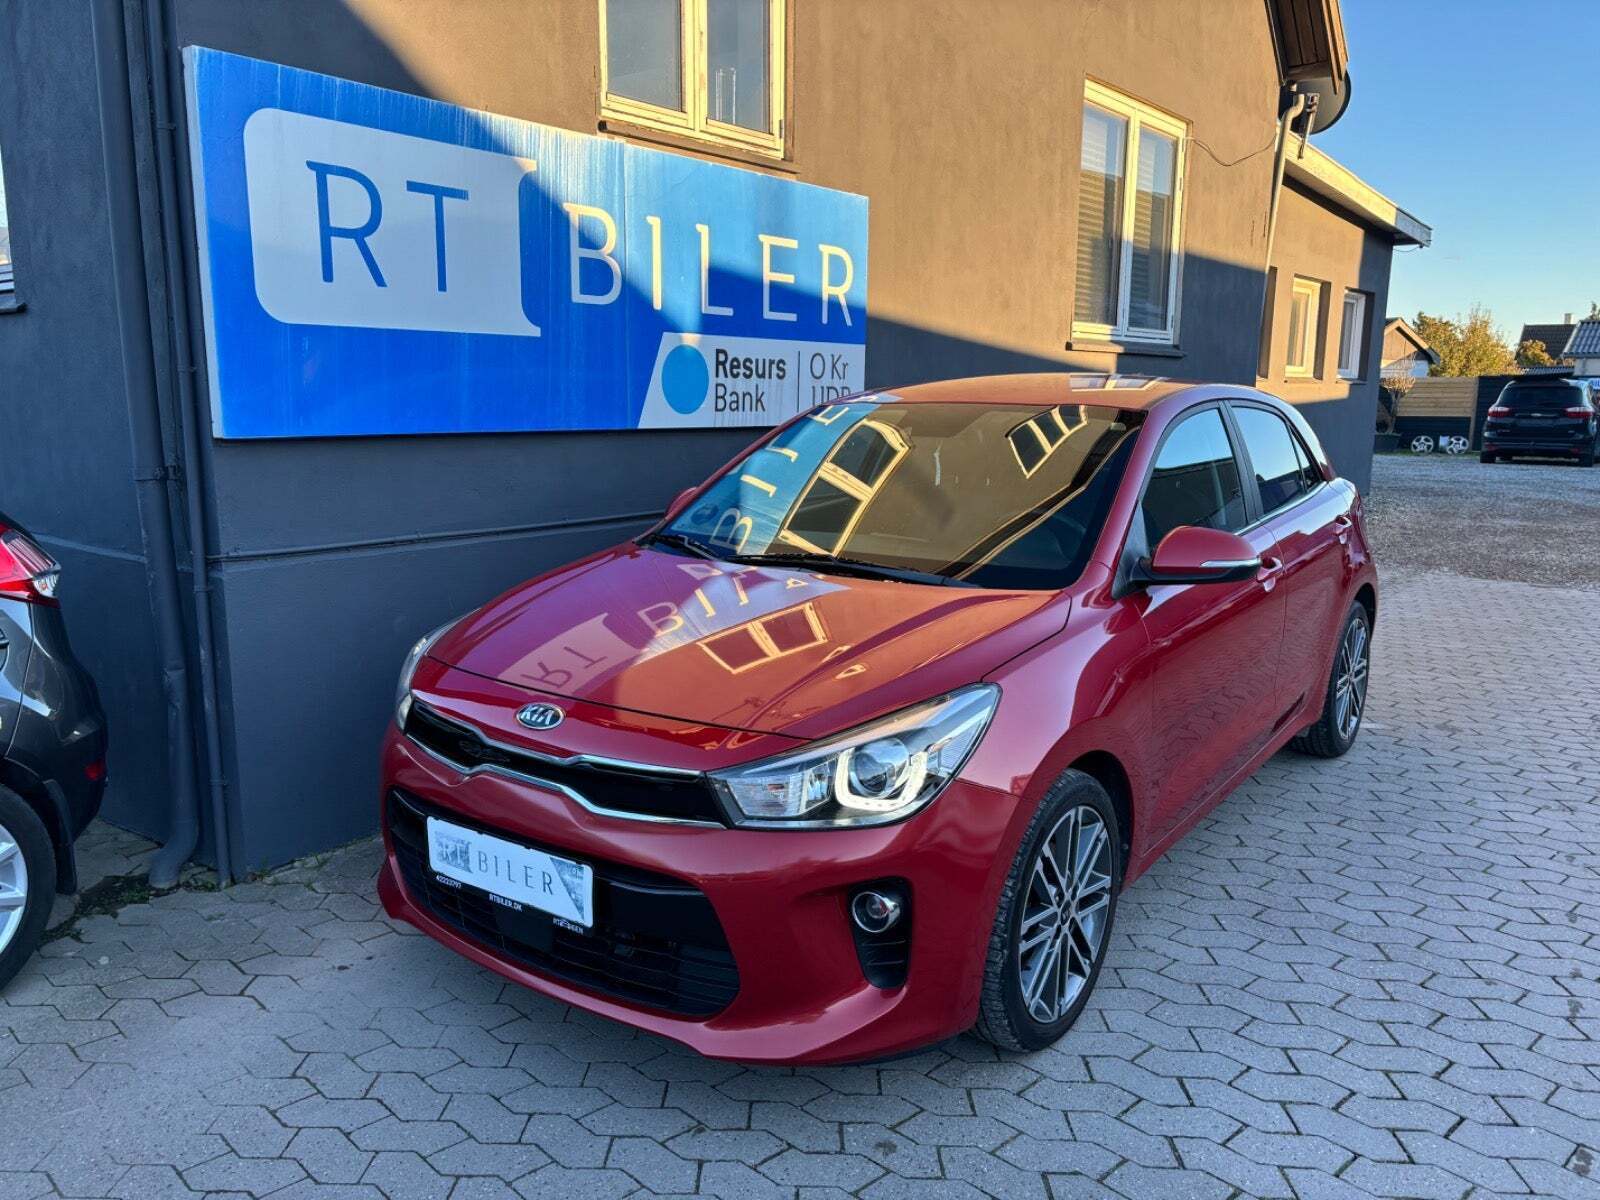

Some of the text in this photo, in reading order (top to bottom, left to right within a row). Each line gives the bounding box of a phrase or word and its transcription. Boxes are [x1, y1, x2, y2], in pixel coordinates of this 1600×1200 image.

[305, 159, 853, 328] RT BILER
[715, 348, 787, 380] Resurs
[714, 382, 766, 413] Bank
[519, 704, 555, 726] KIA
[478, 850, 554, 896] BILER
